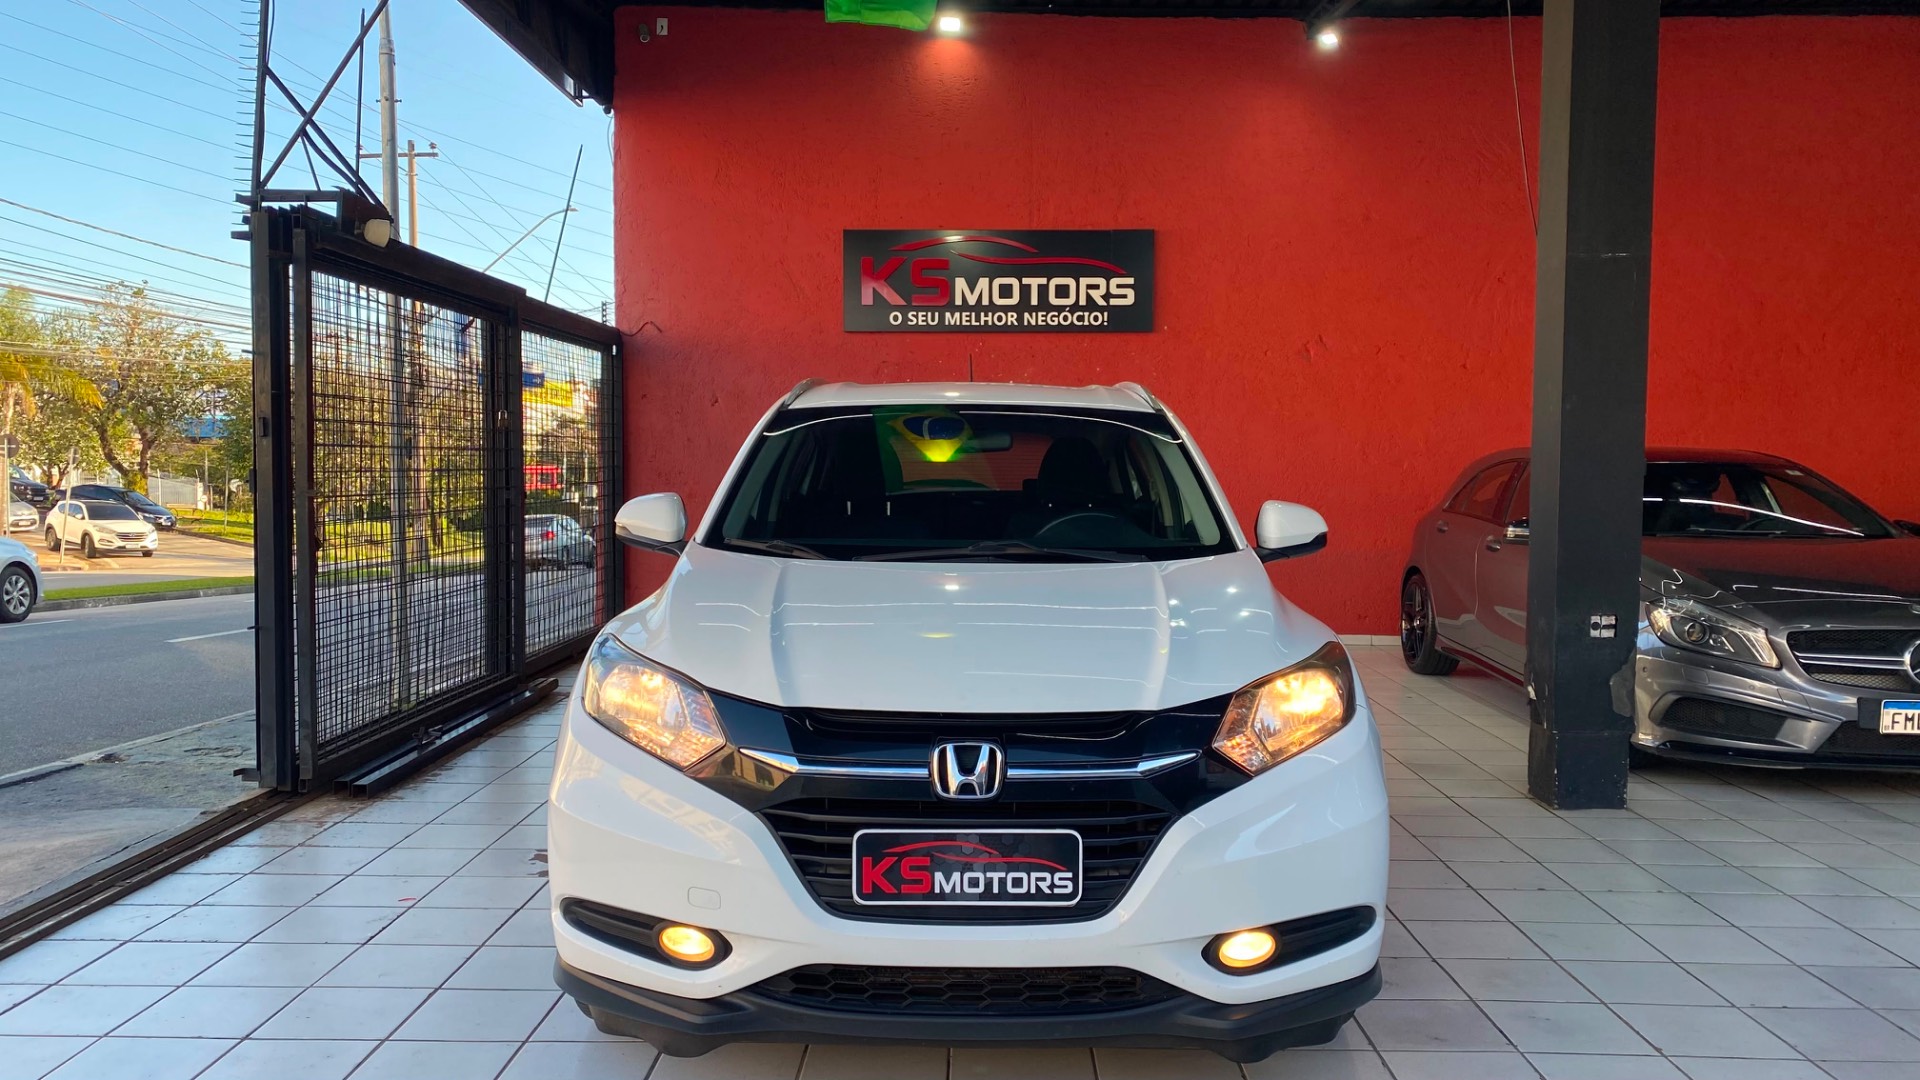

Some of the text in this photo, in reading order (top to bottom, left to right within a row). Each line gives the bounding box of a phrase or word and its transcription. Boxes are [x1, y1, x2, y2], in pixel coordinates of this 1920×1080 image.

[860, 256, 1135, 306] KS MOTORS
[889, 307, 1108, 326] O SEU MELHOR NEGÓCIO!
[862, 857, 1073, 894] KS MOTORS
